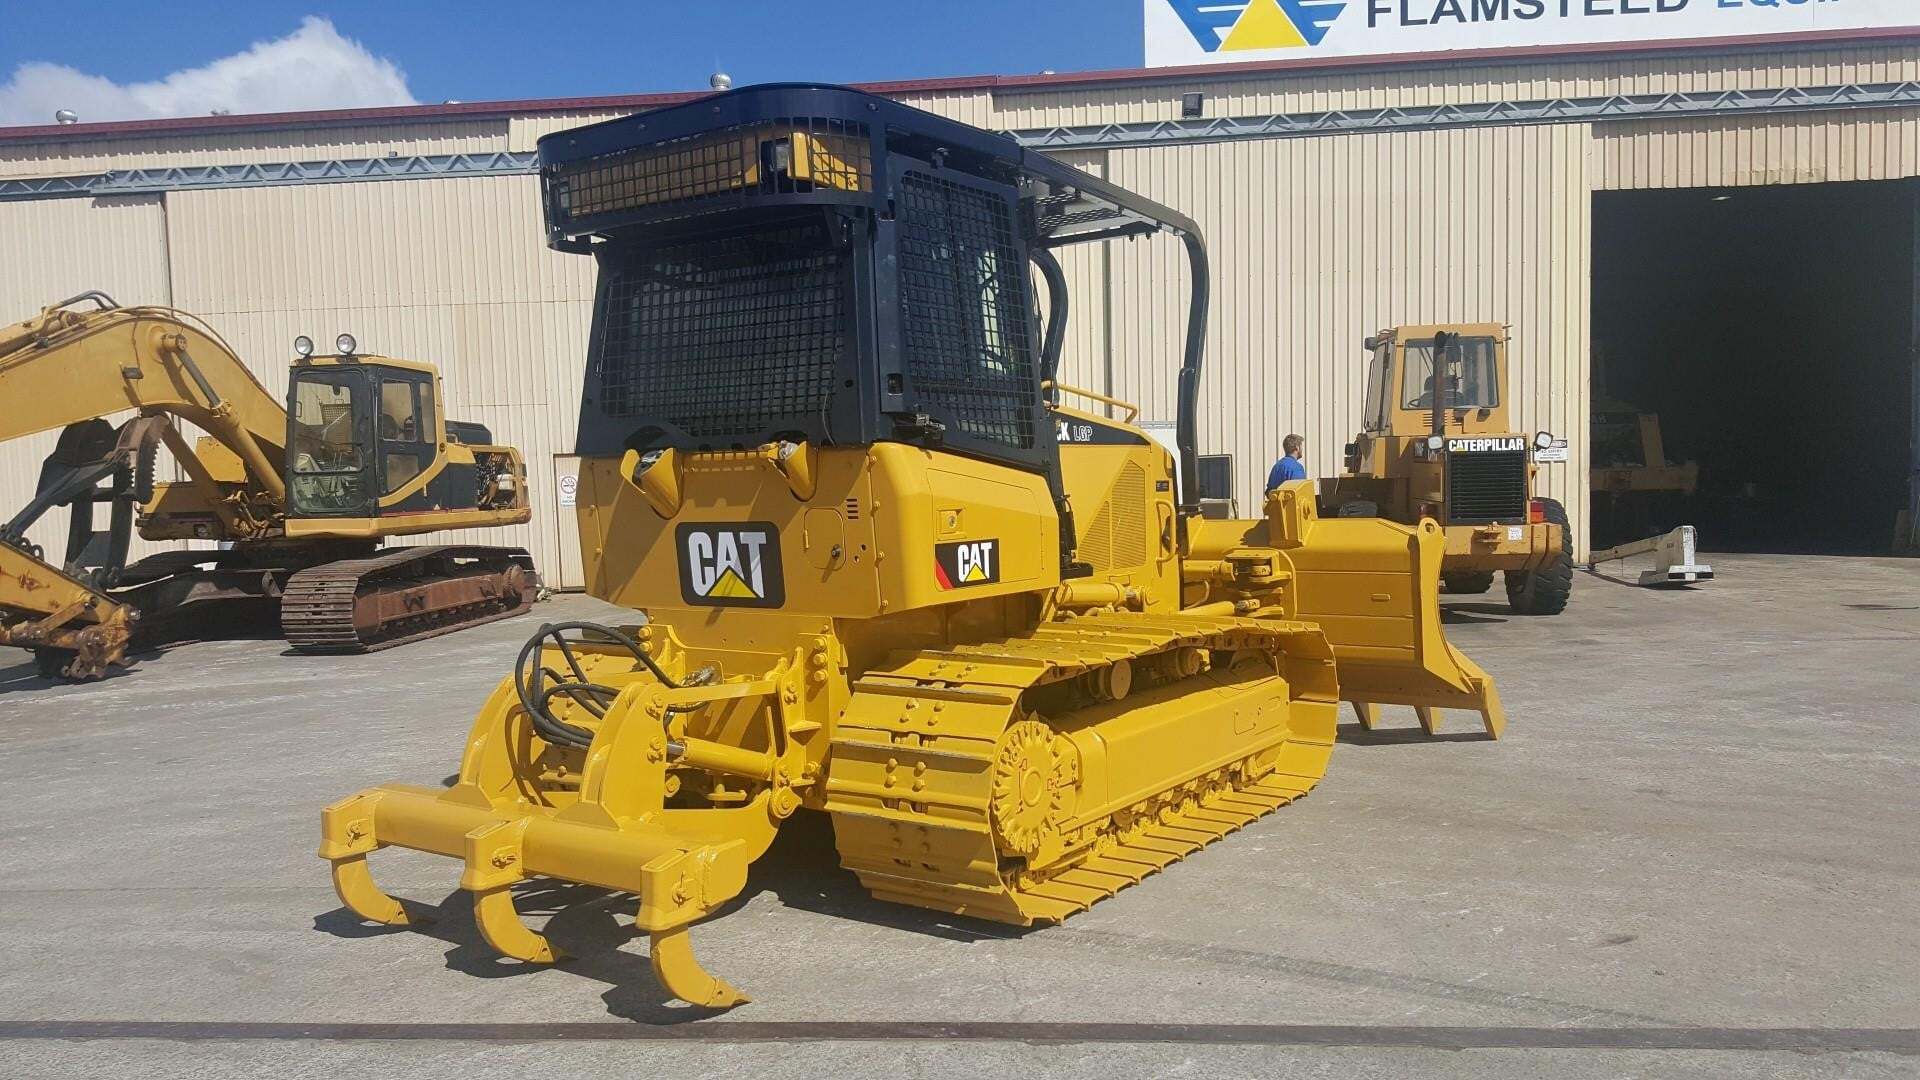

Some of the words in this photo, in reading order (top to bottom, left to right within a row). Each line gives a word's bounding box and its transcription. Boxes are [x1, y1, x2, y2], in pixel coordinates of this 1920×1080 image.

[1073, 425, 1093, 441] LGP
[1448, 438, 1524, 452] CATERPILLAR
[688, 531, 767, 598] CAT
[957, 541, 993, 582] CAT
